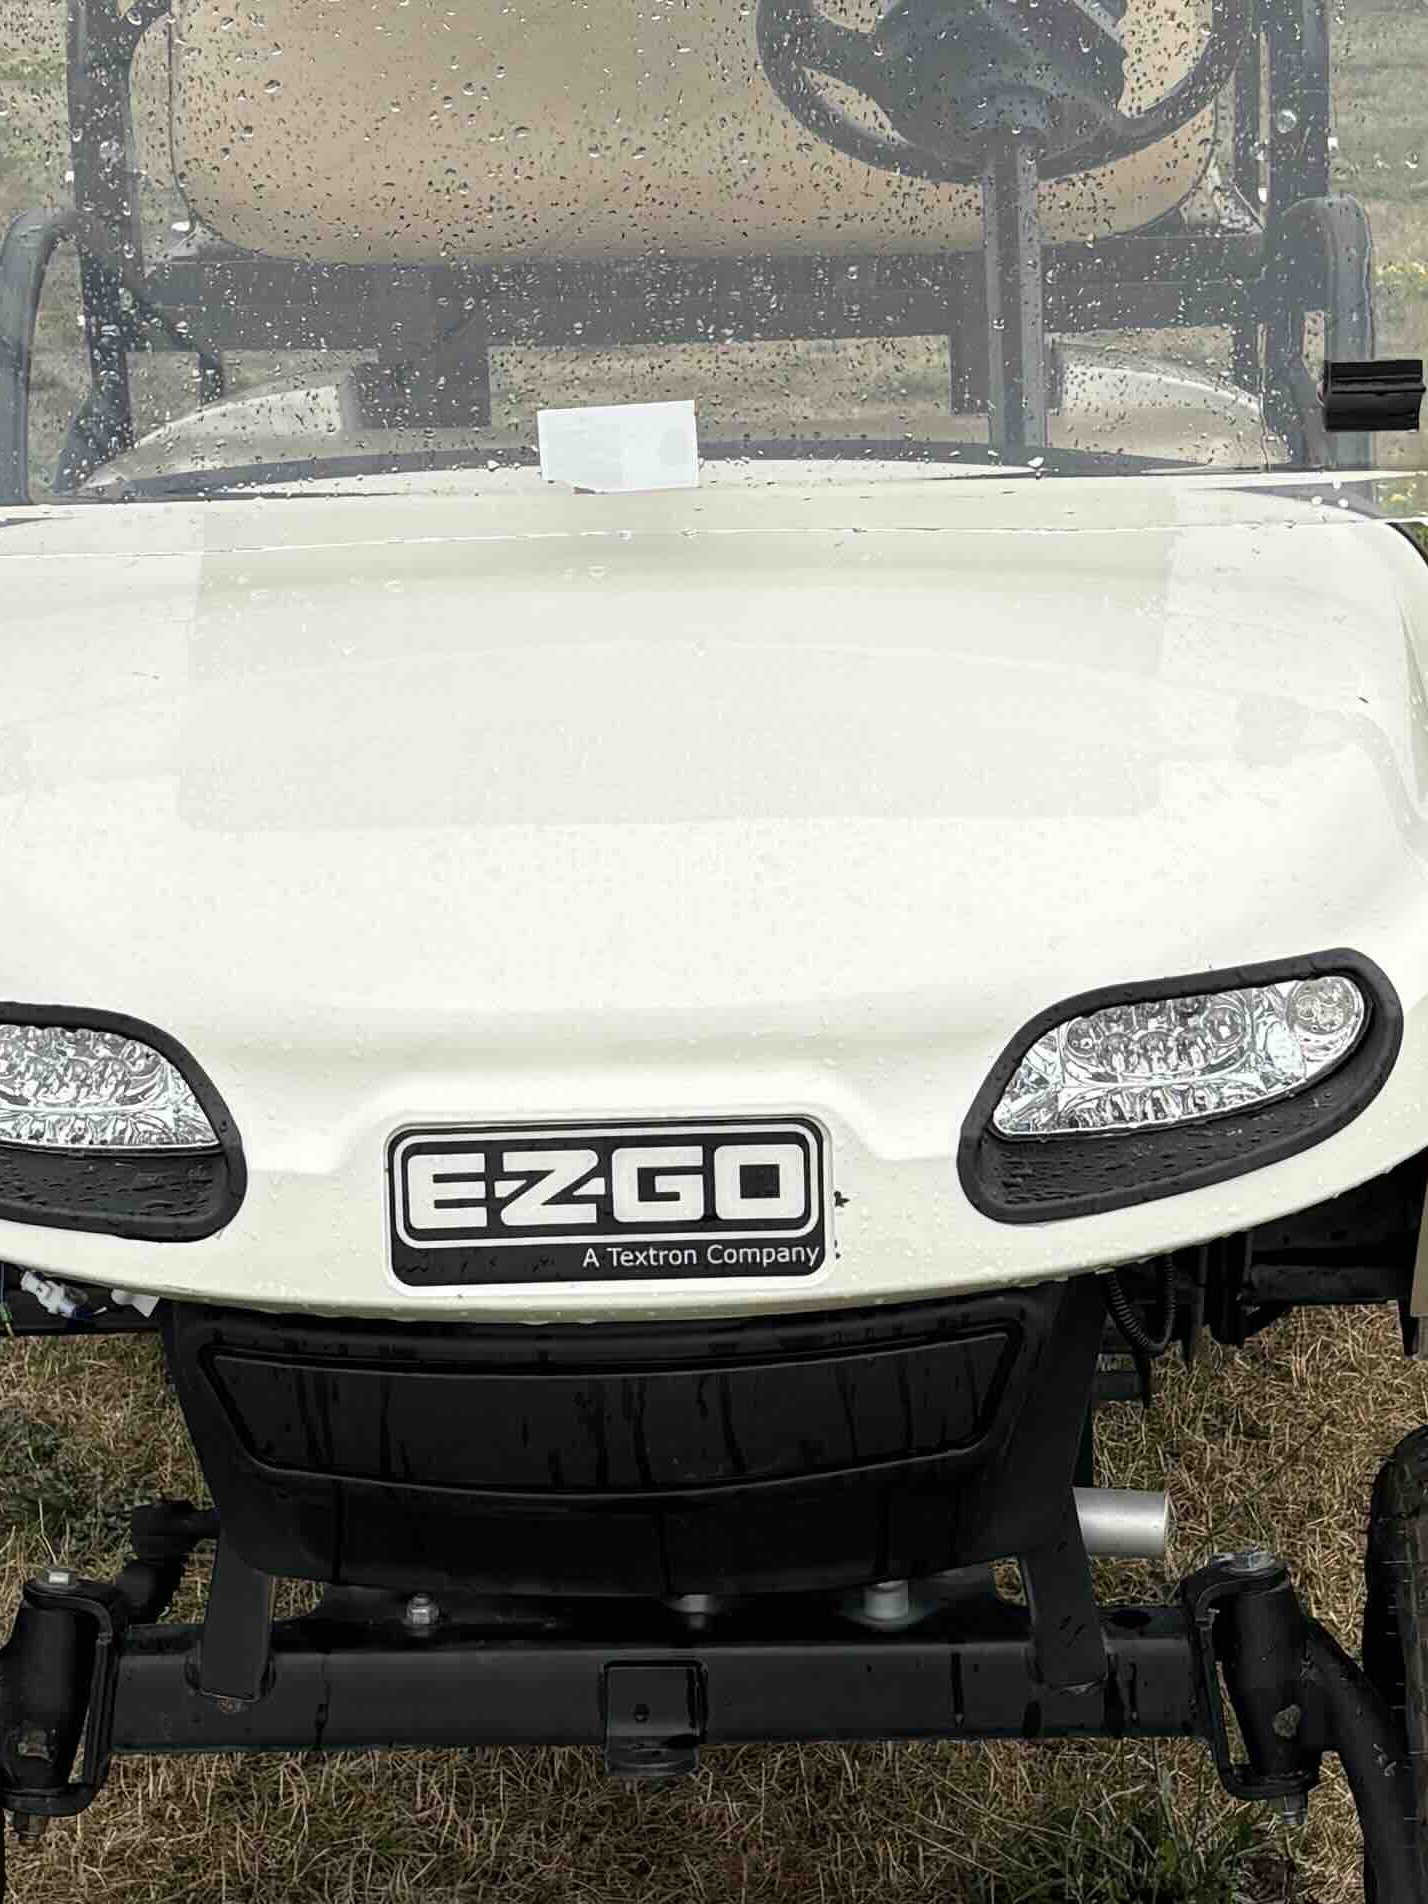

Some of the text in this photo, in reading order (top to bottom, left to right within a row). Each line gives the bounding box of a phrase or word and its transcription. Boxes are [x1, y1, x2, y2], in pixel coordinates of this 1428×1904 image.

[407, 1143, 805, 1230] EZGO
[582, 1244, 820, 1269] A Textron Company
